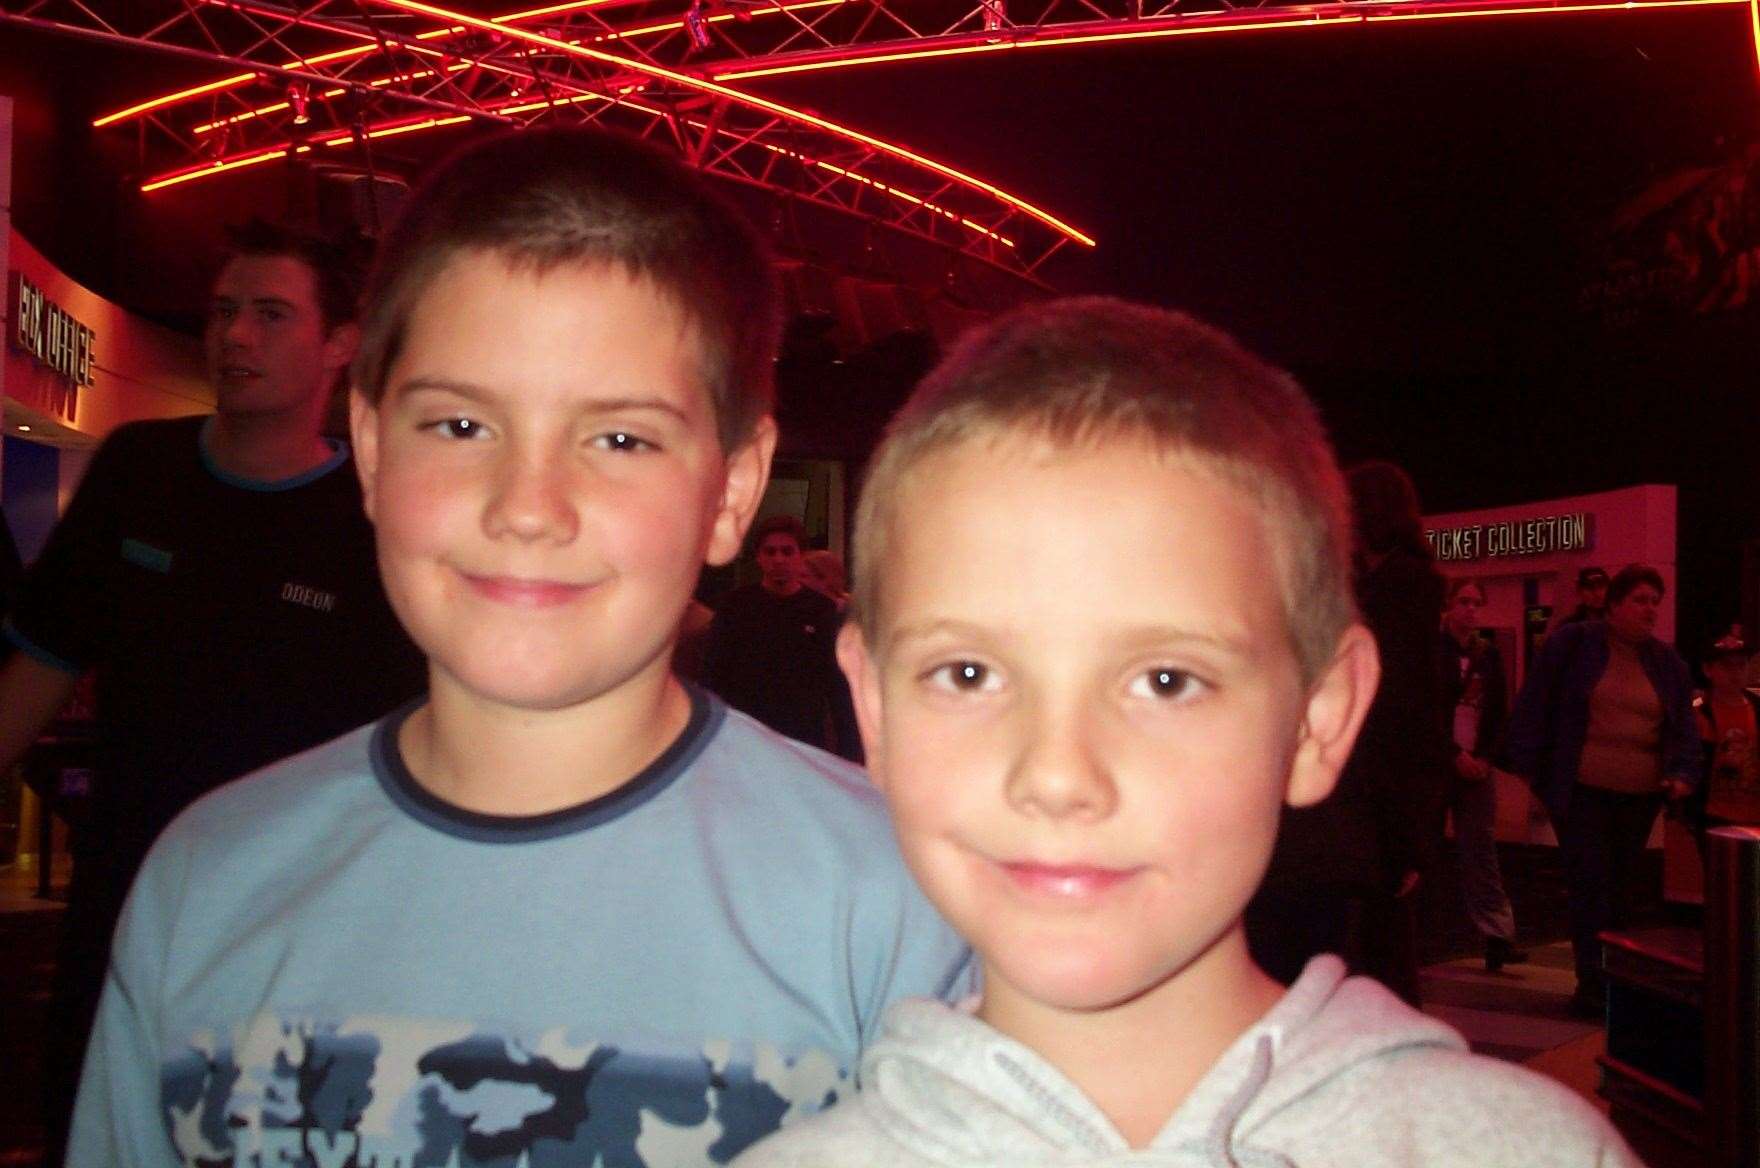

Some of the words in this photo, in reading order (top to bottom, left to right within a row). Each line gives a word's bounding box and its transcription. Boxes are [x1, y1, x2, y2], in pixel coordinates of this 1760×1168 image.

[19, 275, 44, 360] BOX
[46, 303, 96, 389] OFFICE
[1487, 512, 1586, 559] COLLECTION
[281, 582, 336, 612] ODEON
